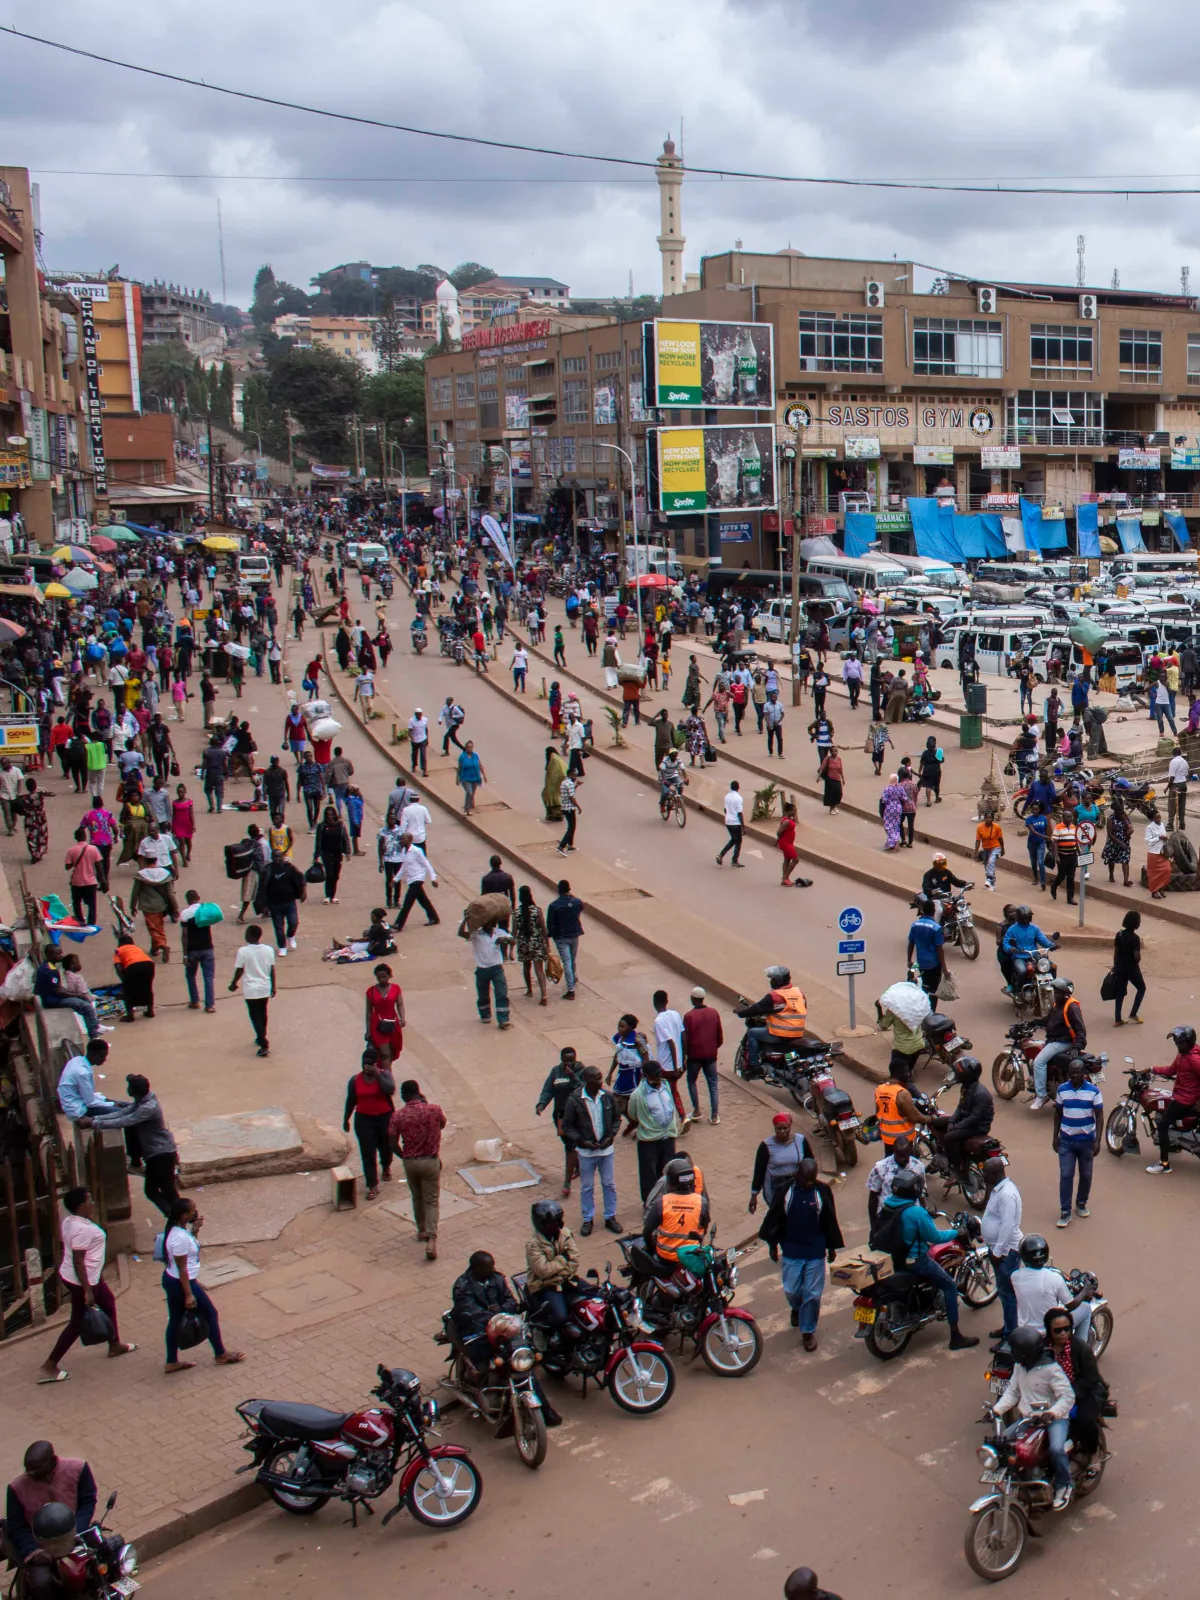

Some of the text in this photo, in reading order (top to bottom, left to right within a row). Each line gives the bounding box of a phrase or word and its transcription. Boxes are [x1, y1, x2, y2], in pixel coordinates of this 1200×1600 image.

[74, 286, 105, 297] HOTEL
[81, 301, 106, 489] CHAINS OF LIBERTY TOWER
[668, 392, 690, 401] Sprite
[829, 406, 964, 428] SASTOS GYM
[673, 498, 695, 508] Sprite
[988, 494, 1019, 504] INTERNET CAFE
[876, 514, 906, 522] PHARMACY
[678, 1213, 685, 1227] 4
